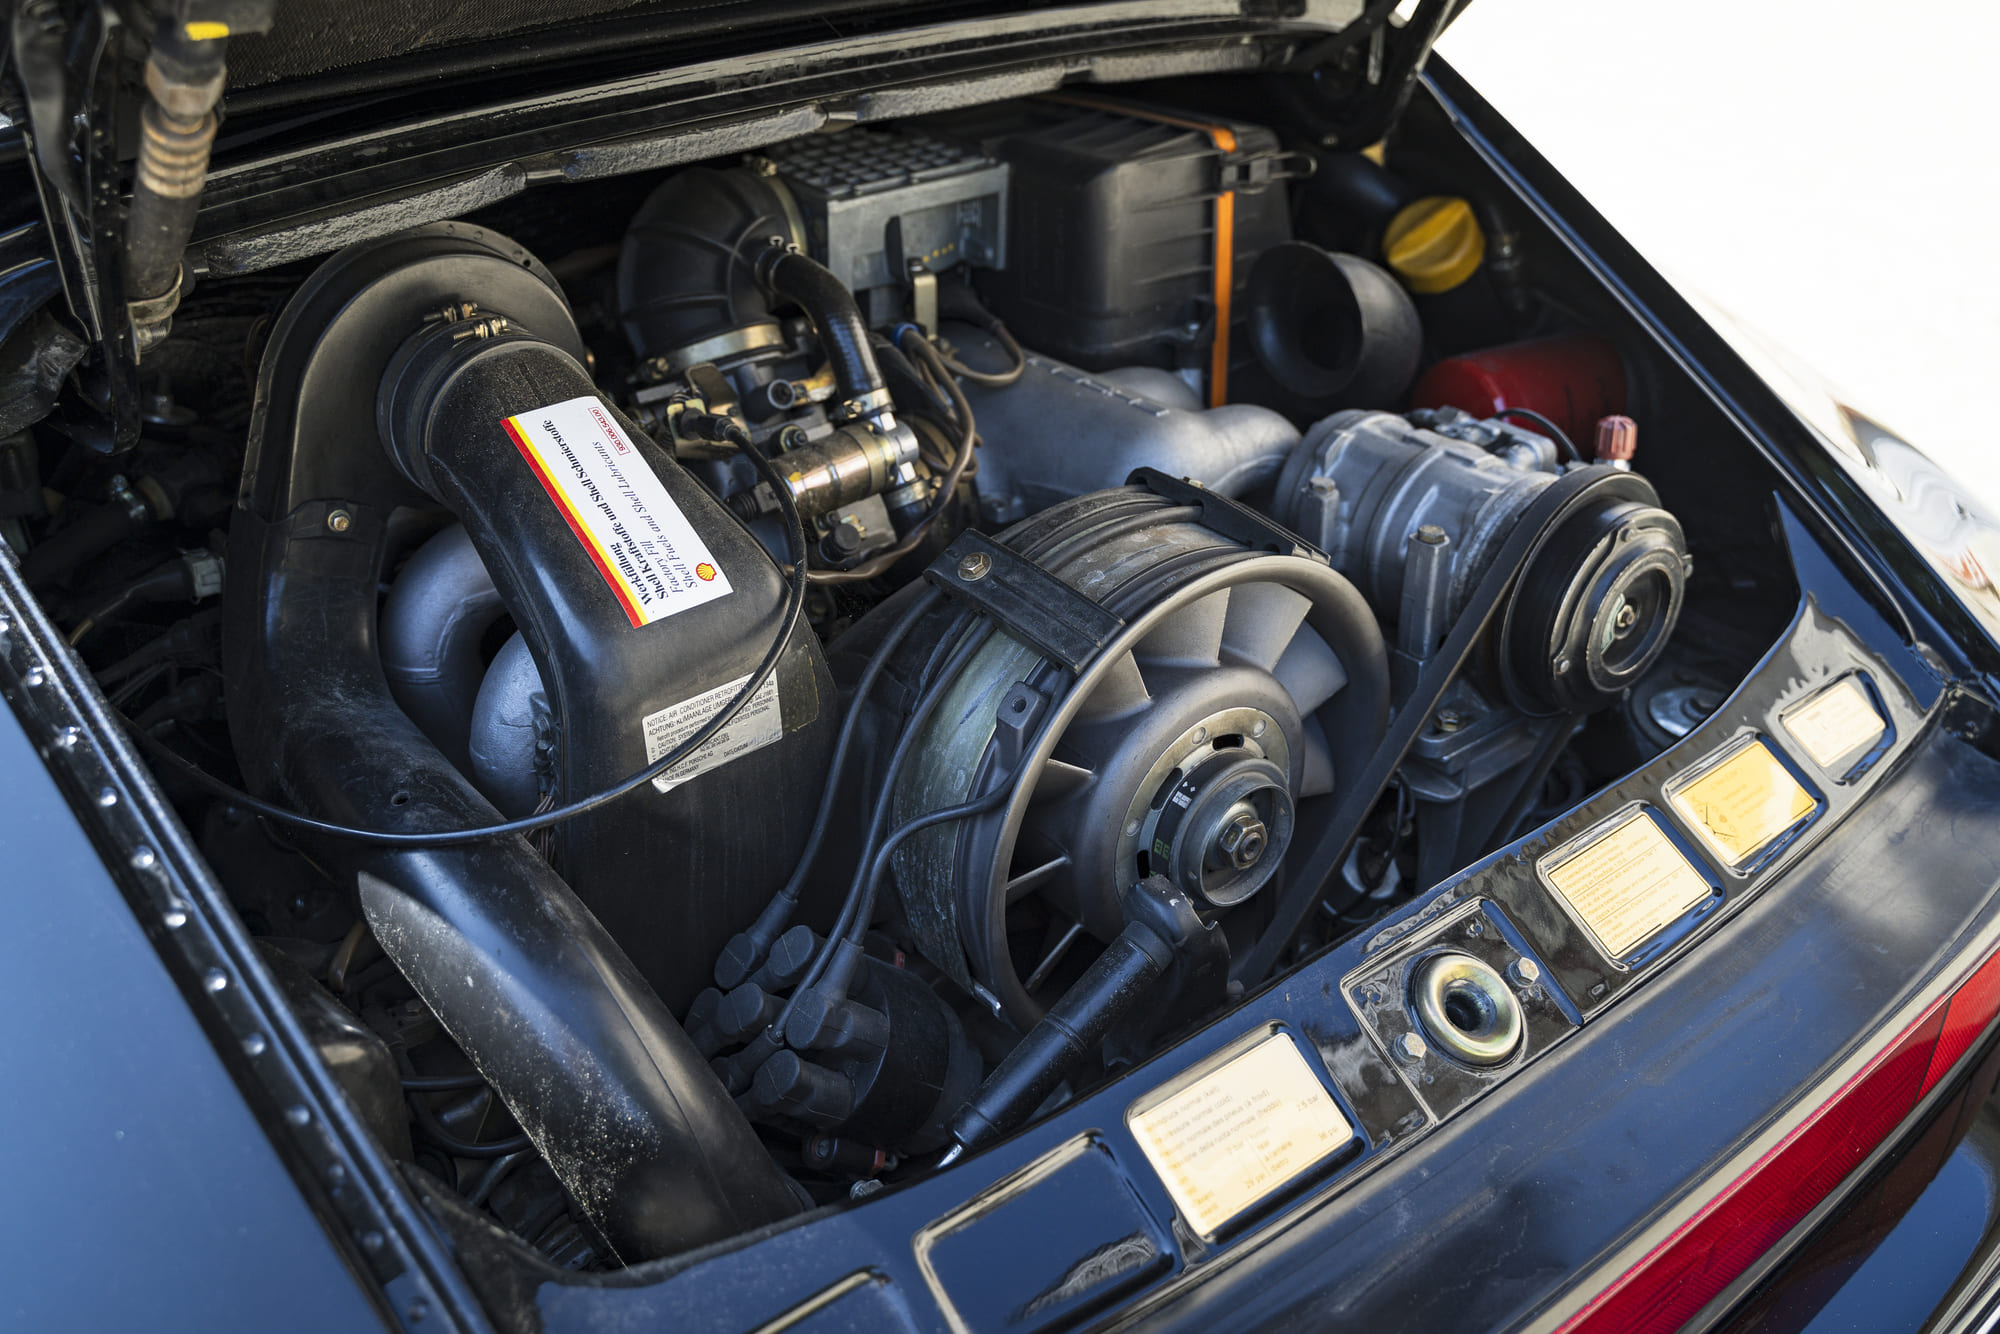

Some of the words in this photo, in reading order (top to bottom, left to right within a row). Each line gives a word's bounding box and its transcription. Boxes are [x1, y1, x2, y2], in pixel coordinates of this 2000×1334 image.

[539, 418, 588, 479] Schmierstoffe
[588, 440, 630, 490] Lubricants
[579, 478, 604, 502] Shell
[622, 489, 647, 514] Shell
[596, 502, 617, 521] und
[640, 514, 661, 534] and
[609, 520, 652, 574] Kraftstoffe
[639, 539, 659, 557] Fill
[653, 533, 681, 562] Fuels
[606, 542, 656, 604] Werkfüllung
[644, 573, 670, 600] Shell
[650, 555, 686, 595] Factory
[672, 562, 699, 589] Shell
[675, 703, 712, 725] KLIMAANLAGE
[678, 694, 714, 714] CONDITIONER
